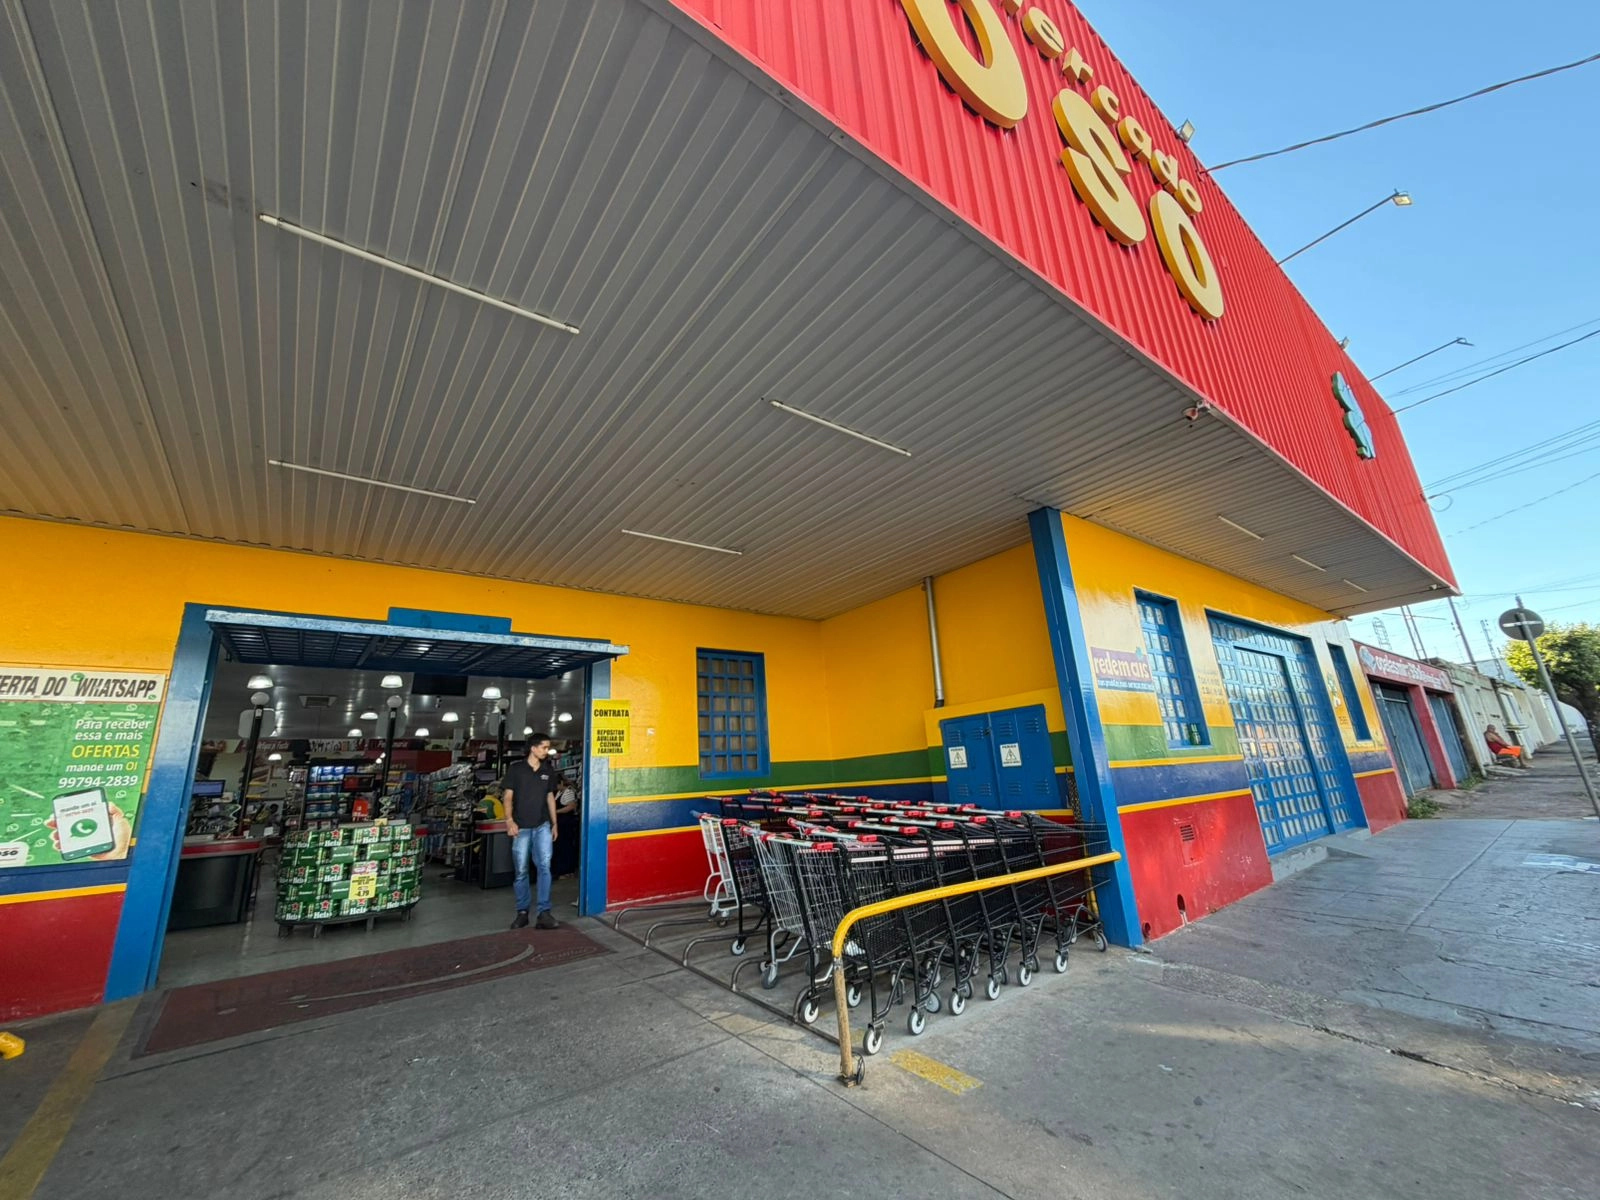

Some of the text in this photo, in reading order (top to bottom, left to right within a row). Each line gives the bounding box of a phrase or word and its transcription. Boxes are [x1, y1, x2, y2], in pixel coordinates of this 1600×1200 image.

[1000, 0, 1203, 216] ercado
[42, 677, 67, 696] DO
[75, 678, 157, 698] WHATSAPP
[594, 709, 629, 717] CONTRATA
[75, 718, 152, 729] Para receber
[74, 730, 143, 741] essa e mais
[71, 744, 140, 759] OFERTAS
[106, 763, 123, 771] um
[58, 775, 138, 789] 99794-2839
